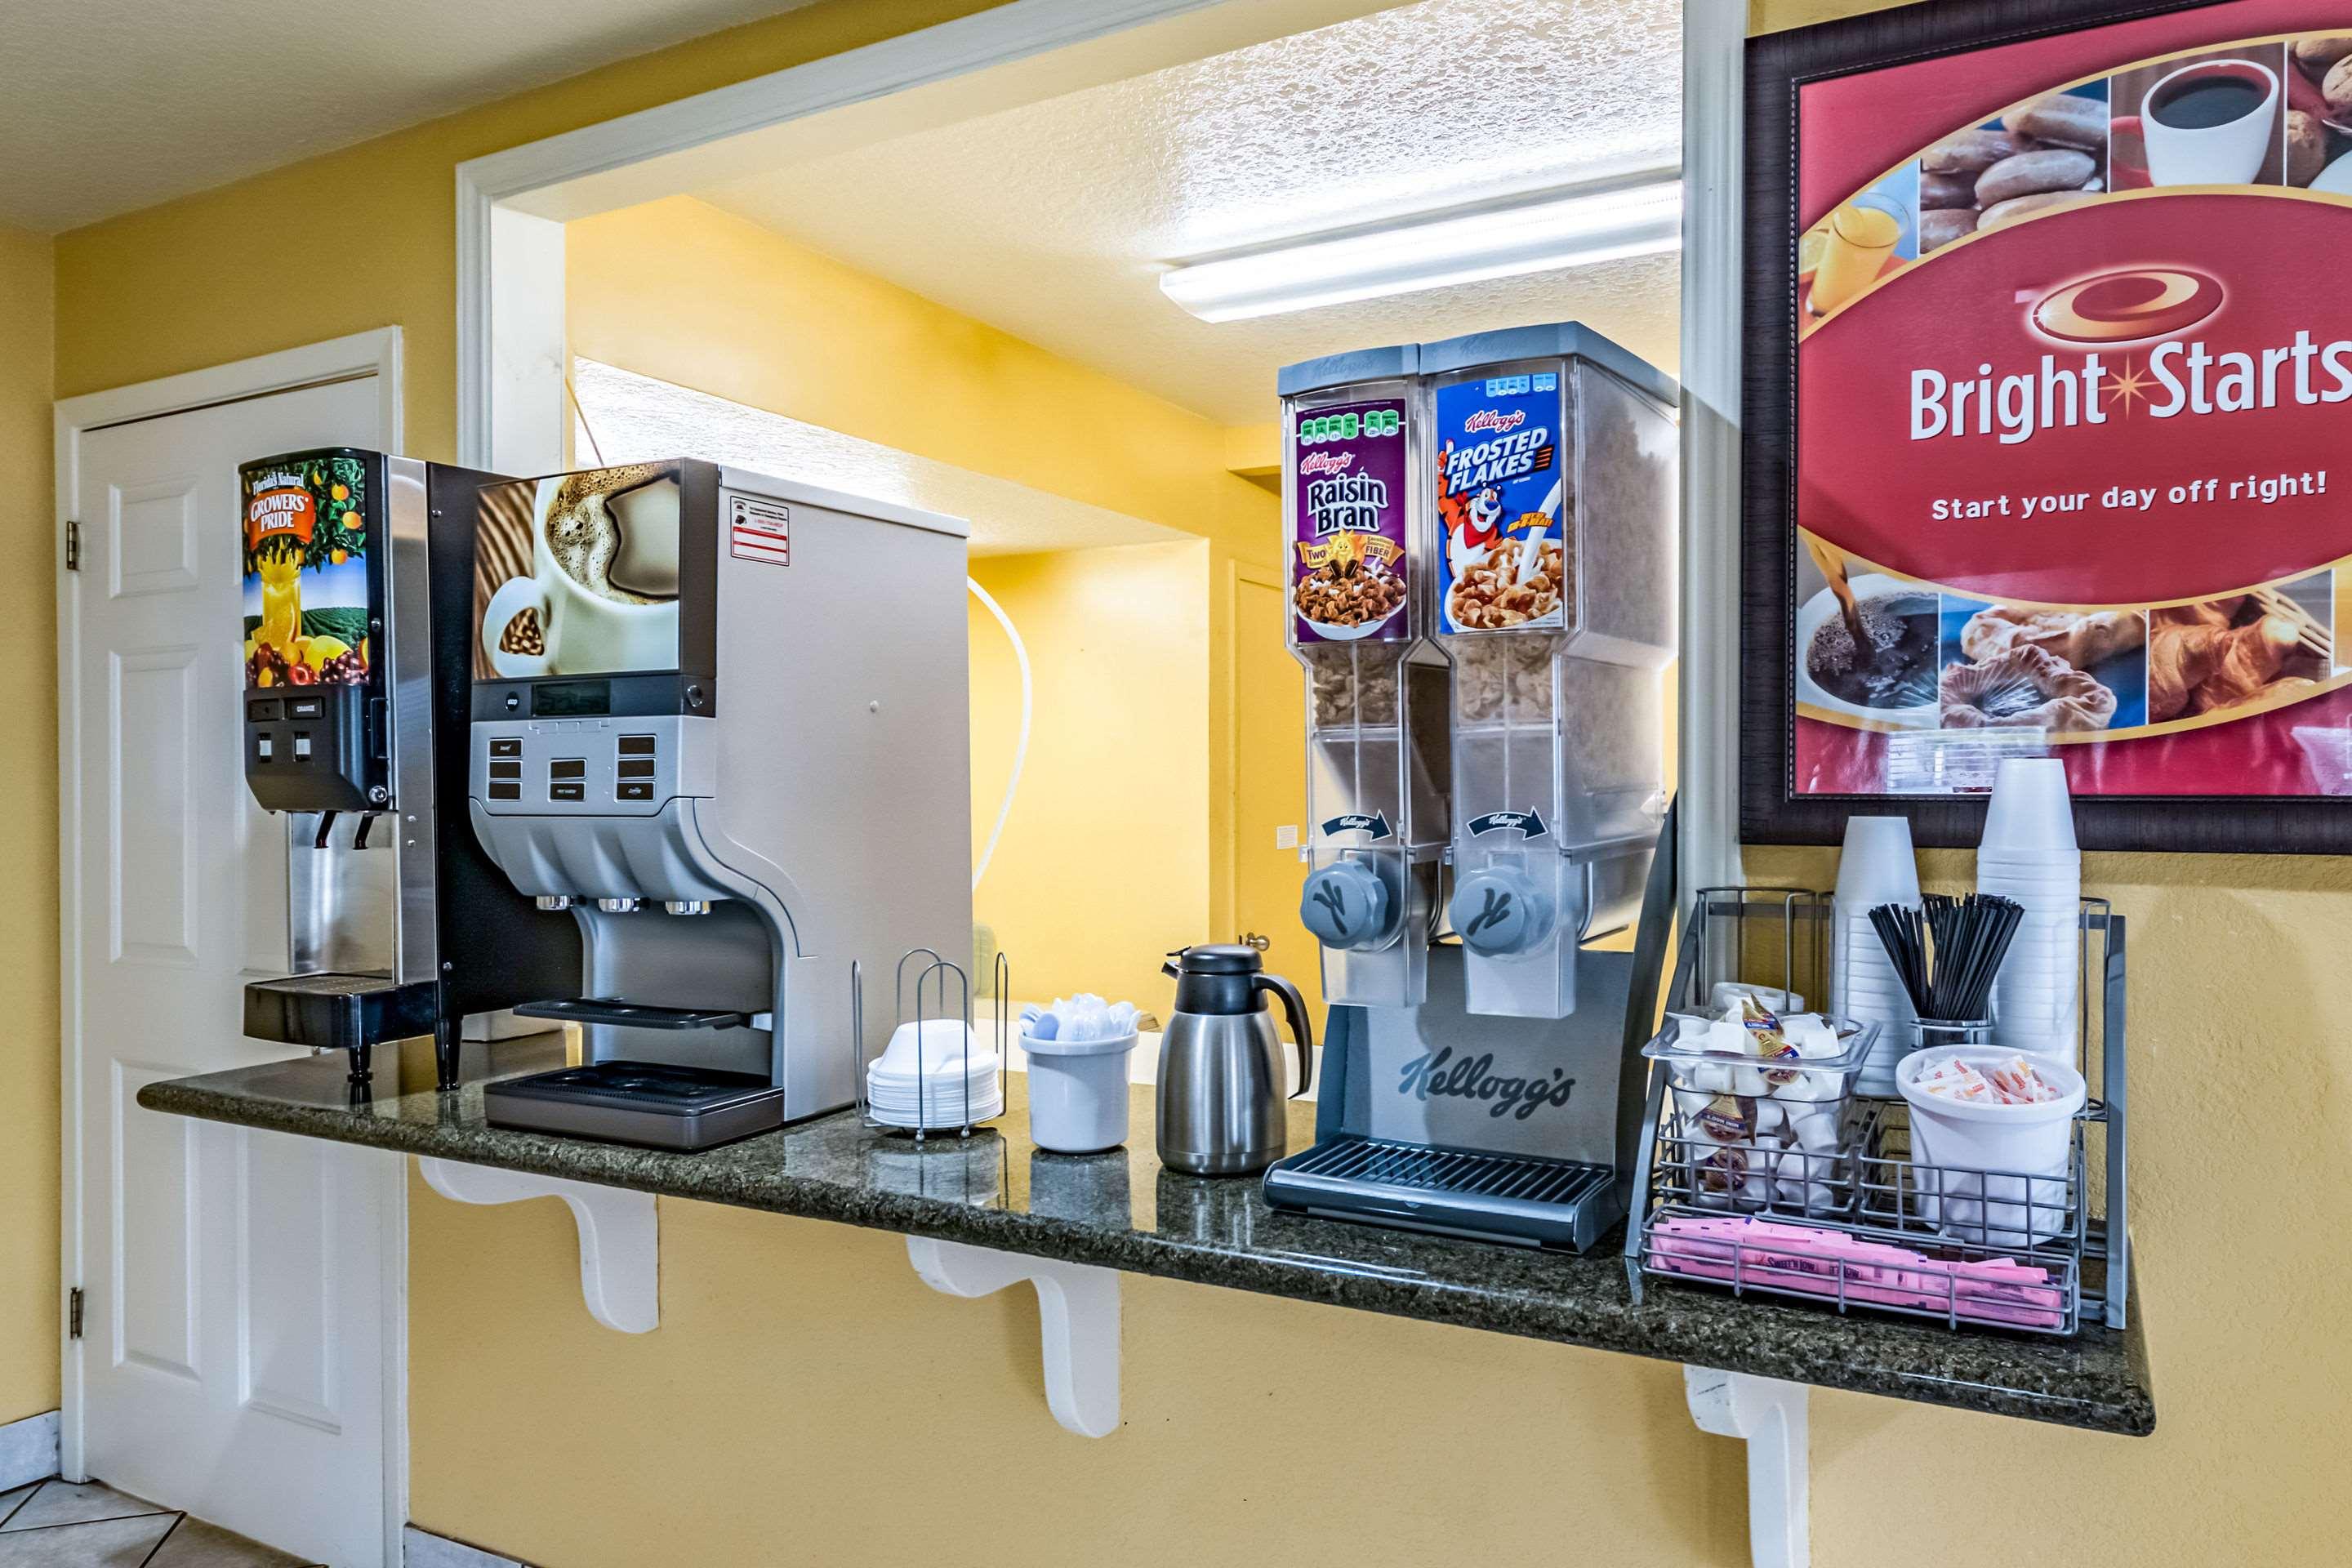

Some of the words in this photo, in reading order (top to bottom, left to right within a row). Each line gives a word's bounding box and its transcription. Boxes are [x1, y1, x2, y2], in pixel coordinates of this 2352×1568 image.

[1911, 353, 2107, 444] Bright
[2149, 330, 2352, 418] Starts
[1465, 410, 1526, 433] Kellogg's
[1300, 452, 1352, 474] Kellogg's
[1446, 428, 1548, 476] FROSTED
[1448, 451, 1535, 495] FLAKES
[1308, 474, 1387, 513] Raisin
[1931, 494, 2011, 520] Start
[2020, 492, 2091, 519] your
[2101, 486, 2157, 511] day
[2168, 479, 2219, 504] off
[2230, 470, 2327, 504] right!
[261, 510, 295, 532] PRIDE
[1316, 506, 1379, 535] Bran
[1365, 546, 1390, 557] FIBER
[1398, 1046, 1576, 1120] Kellogg's
